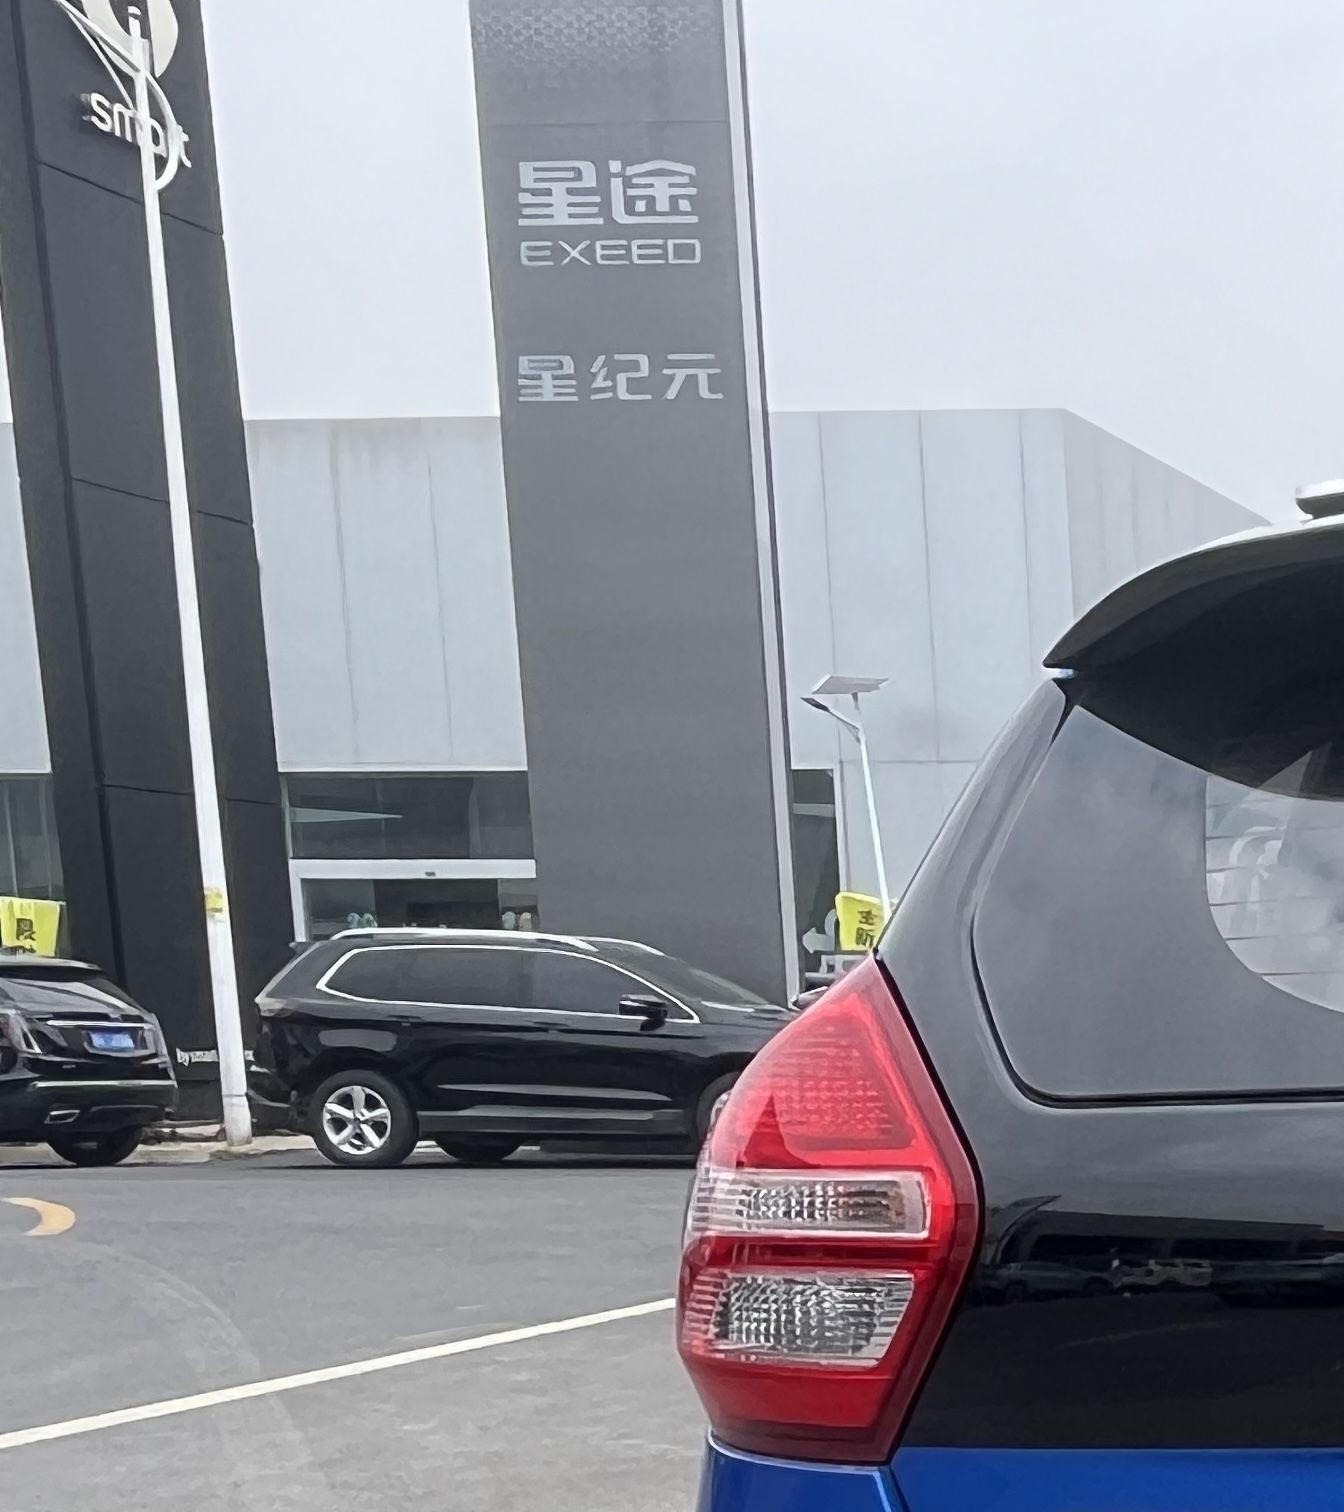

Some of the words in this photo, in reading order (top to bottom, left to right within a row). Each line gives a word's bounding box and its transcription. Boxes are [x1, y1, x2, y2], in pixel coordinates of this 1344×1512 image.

[517, 159, 700, 226] 星途
[520, 239, 701, 266] EXEED
[517, 353, 724, 401] 星纪元
